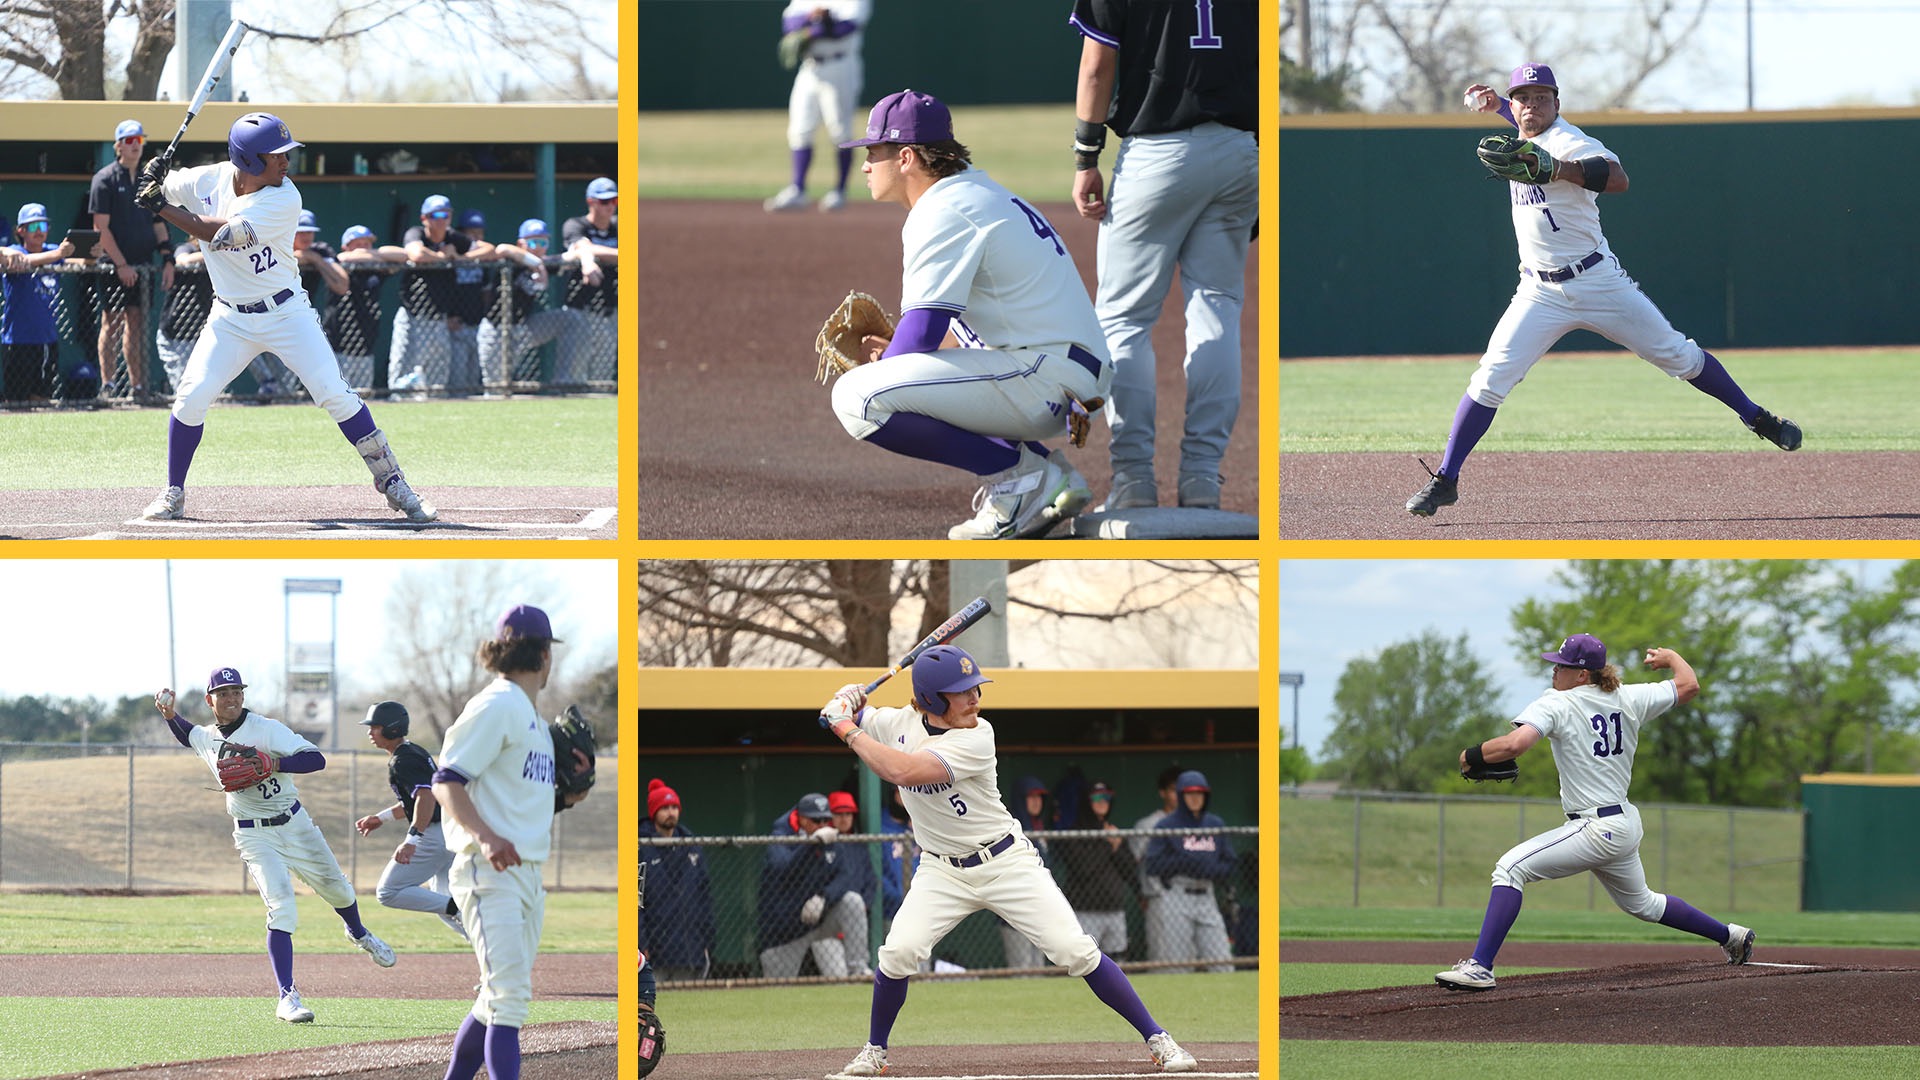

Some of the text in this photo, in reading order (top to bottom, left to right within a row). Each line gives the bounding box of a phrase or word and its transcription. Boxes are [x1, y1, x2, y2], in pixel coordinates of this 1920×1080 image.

[1542, 208, 1560, 232] 1
[249, 246, 278, 275] 22
[1590, 711, 1624, 758] 31
[257, 777, 281, 800] 23
[948, 793, 968, 817] 5
